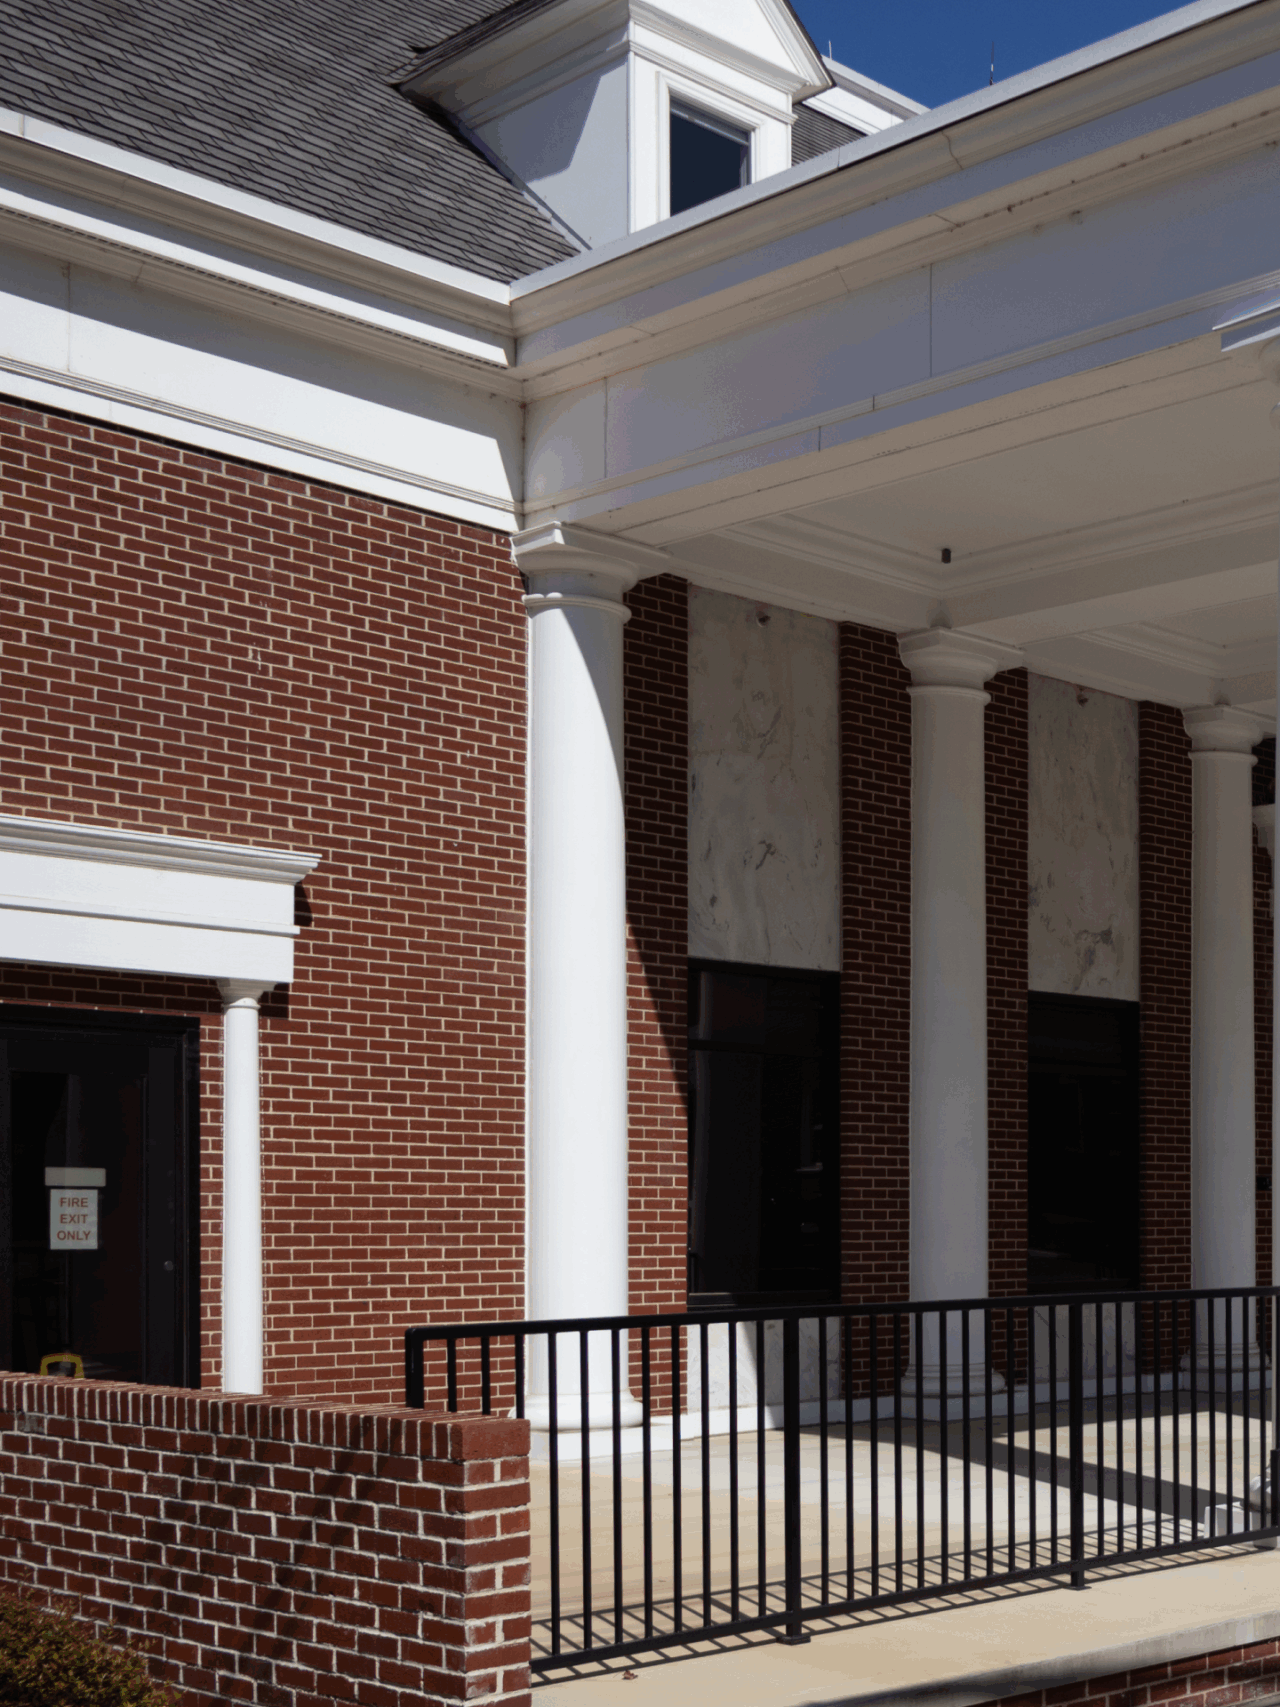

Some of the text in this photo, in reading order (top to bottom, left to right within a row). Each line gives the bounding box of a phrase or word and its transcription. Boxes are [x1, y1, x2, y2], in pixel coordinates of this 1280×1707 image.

[59, 1197, 88, 1208] FIRE
[59, 1214, 88, 1224] EXIT
[56, 1230, 91, 1241] ONLY
